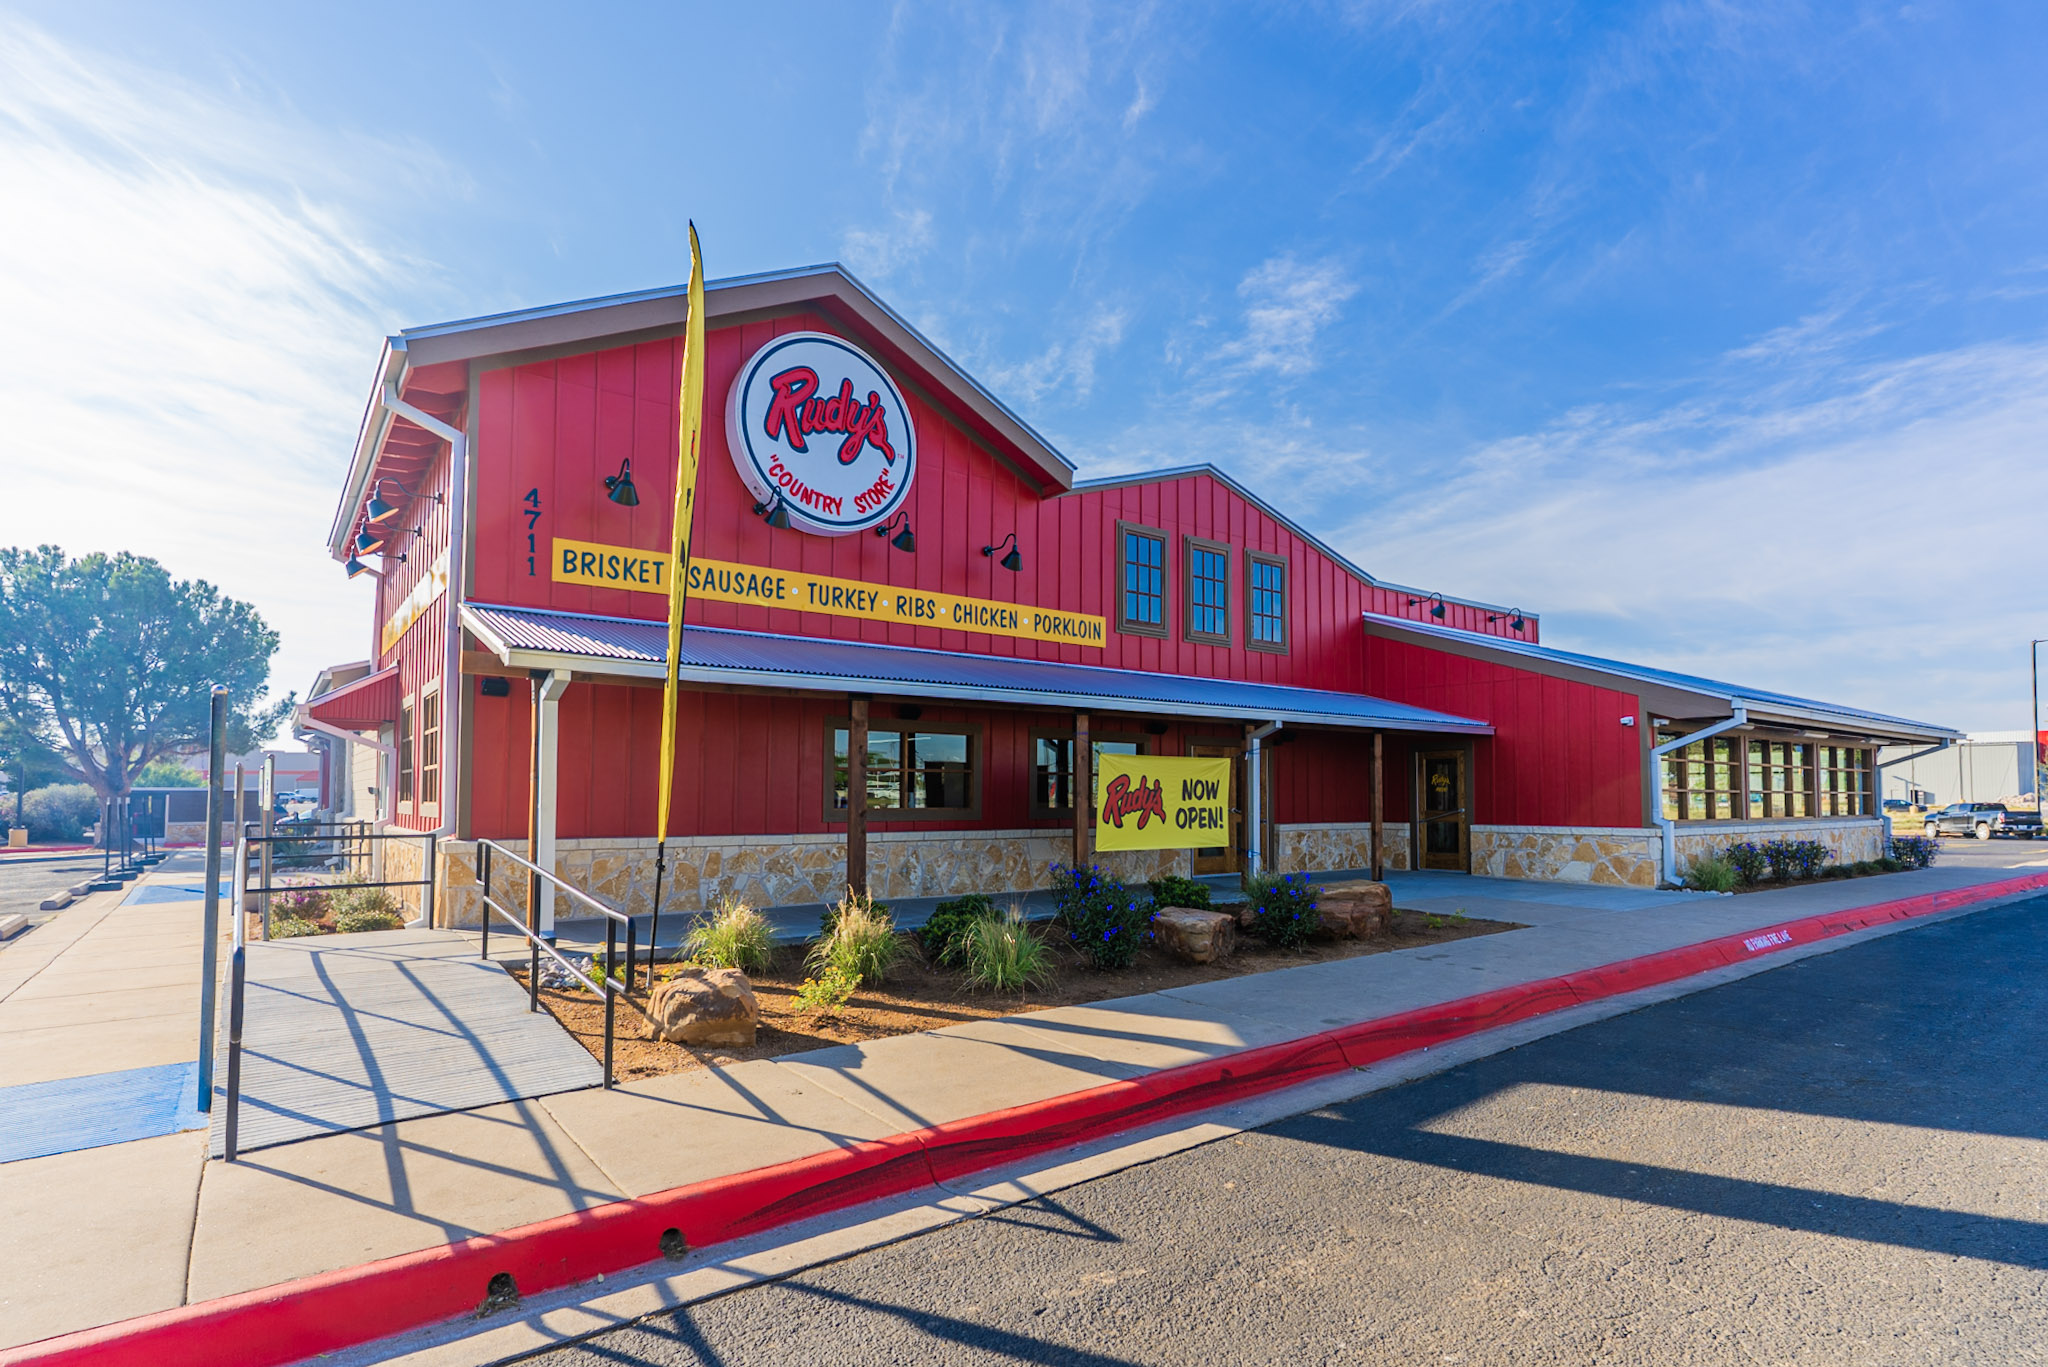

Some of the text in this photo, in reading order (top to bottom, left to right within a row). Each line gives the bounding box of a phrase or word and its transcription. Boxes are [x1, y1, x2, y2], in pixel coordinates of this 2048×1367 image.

[764, 365, 895, 467] Rudy's
[768, 454, 895, 516] "COUNTRY STORE"
[523, 488, 542, 577] 4711
[562, 549, 1102, 640] BRISKET SAUSAGE TURKEY RIBS CHICKEN PORKLOIN
[1102, 773, 1166, 830] Rudy's
[1175, 806, 1224, 829] OPEN!
[1182, 778, 1220, 801] NOW
